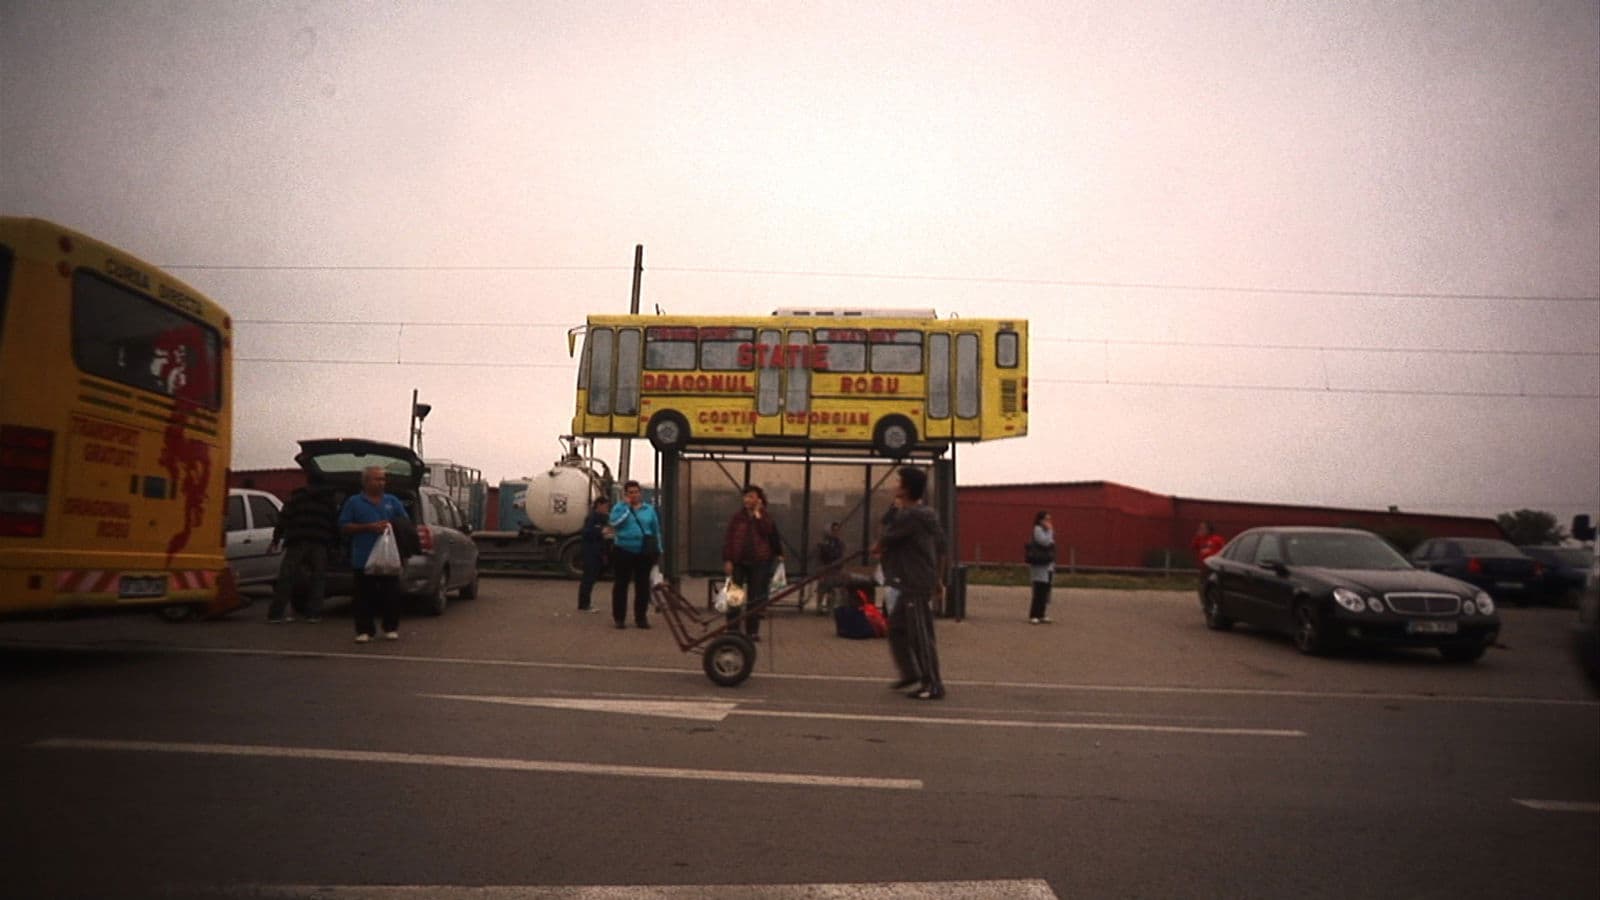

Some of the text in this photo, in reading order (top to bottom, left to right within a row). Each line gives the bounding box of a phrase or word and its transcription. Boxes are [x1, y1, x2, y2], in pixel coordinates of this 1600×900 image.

[737, 342, 830, 369] STATIE
[643, 373, 899, 393] DRAGONUL ROSU
[786, 411, 870, 426] GEORGIAN
